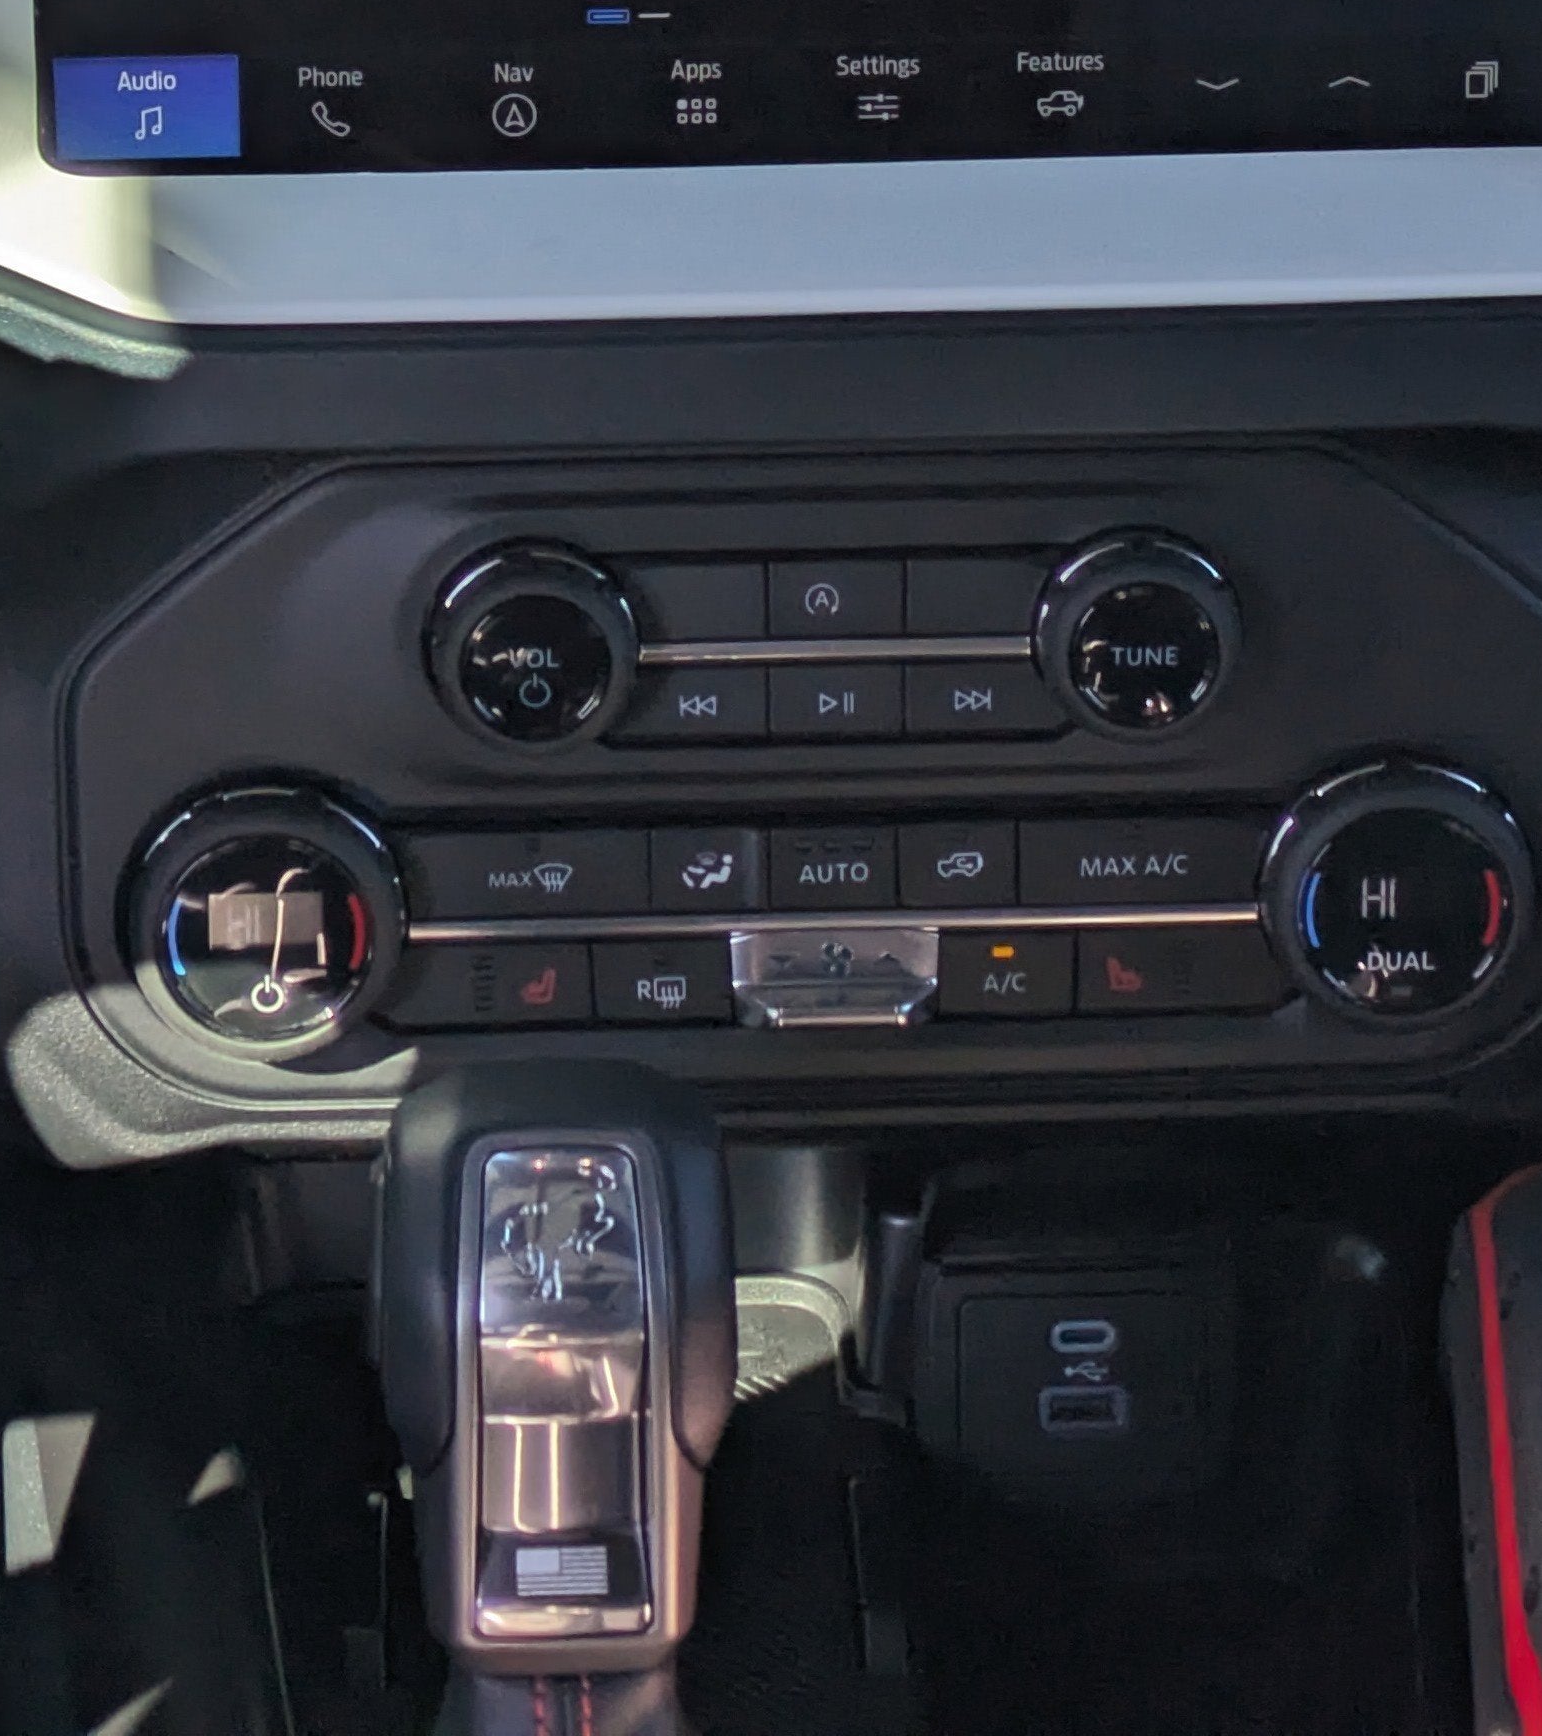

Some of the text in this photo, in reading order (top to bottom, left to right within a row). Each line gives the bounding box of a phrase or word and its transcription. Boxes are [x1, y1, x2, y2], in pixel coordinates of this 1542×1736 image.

[494, 62, 534, 83] Nav
[670, 59, 722, 83] Apps
[836, 55, 921, 79] Settings
[1016, 51, 1105, 73] Features
[117, 70, 177, 92] Audio
[297, 66, 364, 88] Phone
[507, 648, 560, 670] VOL
[1110, 645, 1177, 667] TUNE
[799, 861, 869, 884] AUTO
[1080, 853, 1187, 877] MAX A/C
[488, 871, 532, 888] MAX
[1361, 878, 1396, 918] HI
[1364, 949, 1438, 973] DUAL
[983, 972, 1026, 995] A/C
